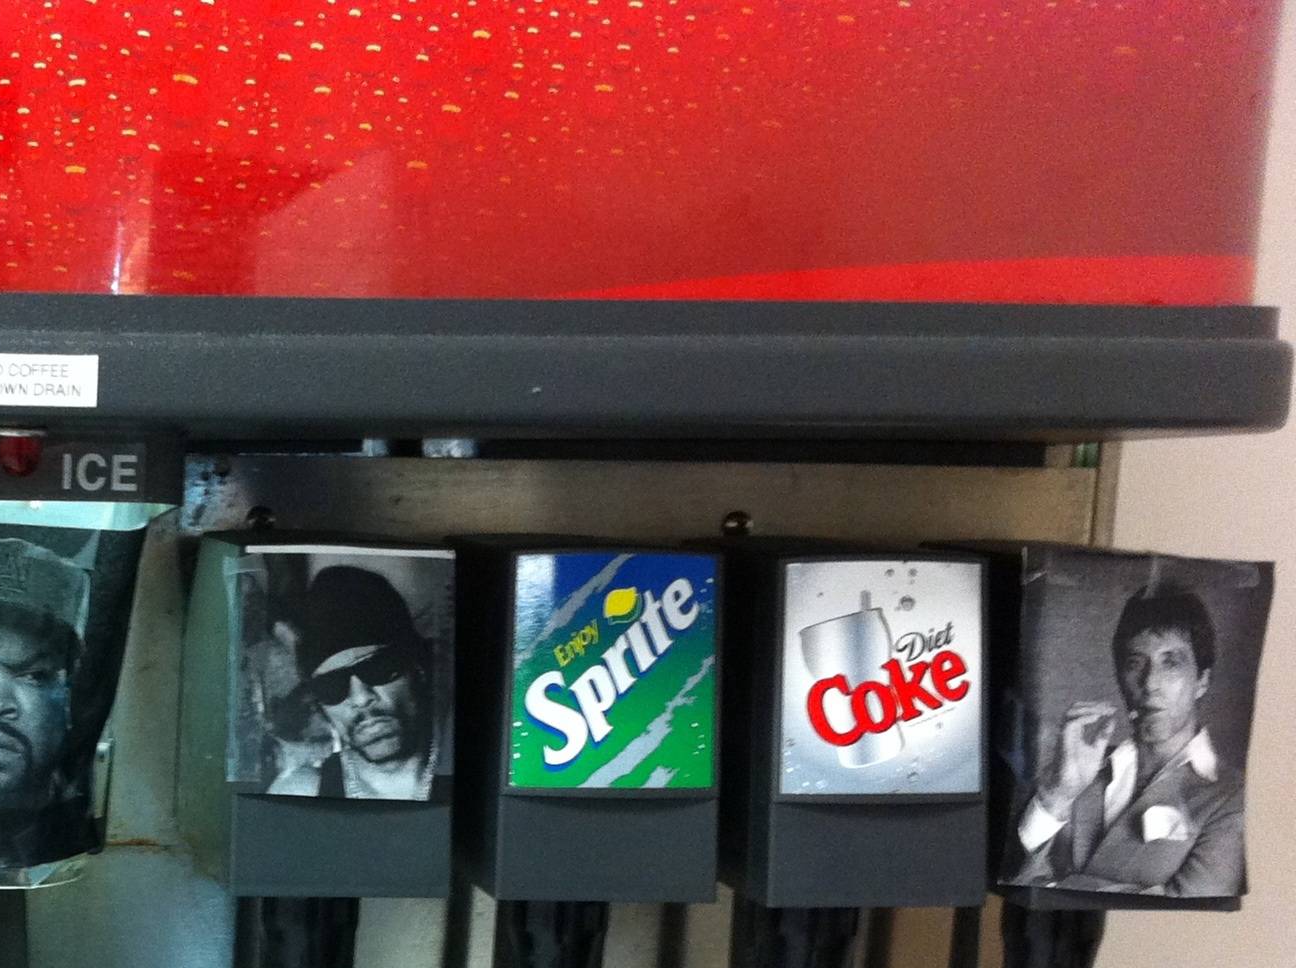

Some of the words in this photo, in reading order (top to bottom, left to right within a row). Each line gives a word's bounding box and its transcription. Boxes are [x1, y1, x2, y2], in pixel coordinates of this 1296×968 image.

[7, 362, 70, 378] COFFEE
[32, 382, 82, 397] DRAIN
[61, 452, 139, 492] ICE
[553, 619, 600, 668] Enjoy
[895, 621, 954, 662] Diet
[524, 577, 701, 767] Sprite
[807, 650, 971, 747] Coke
